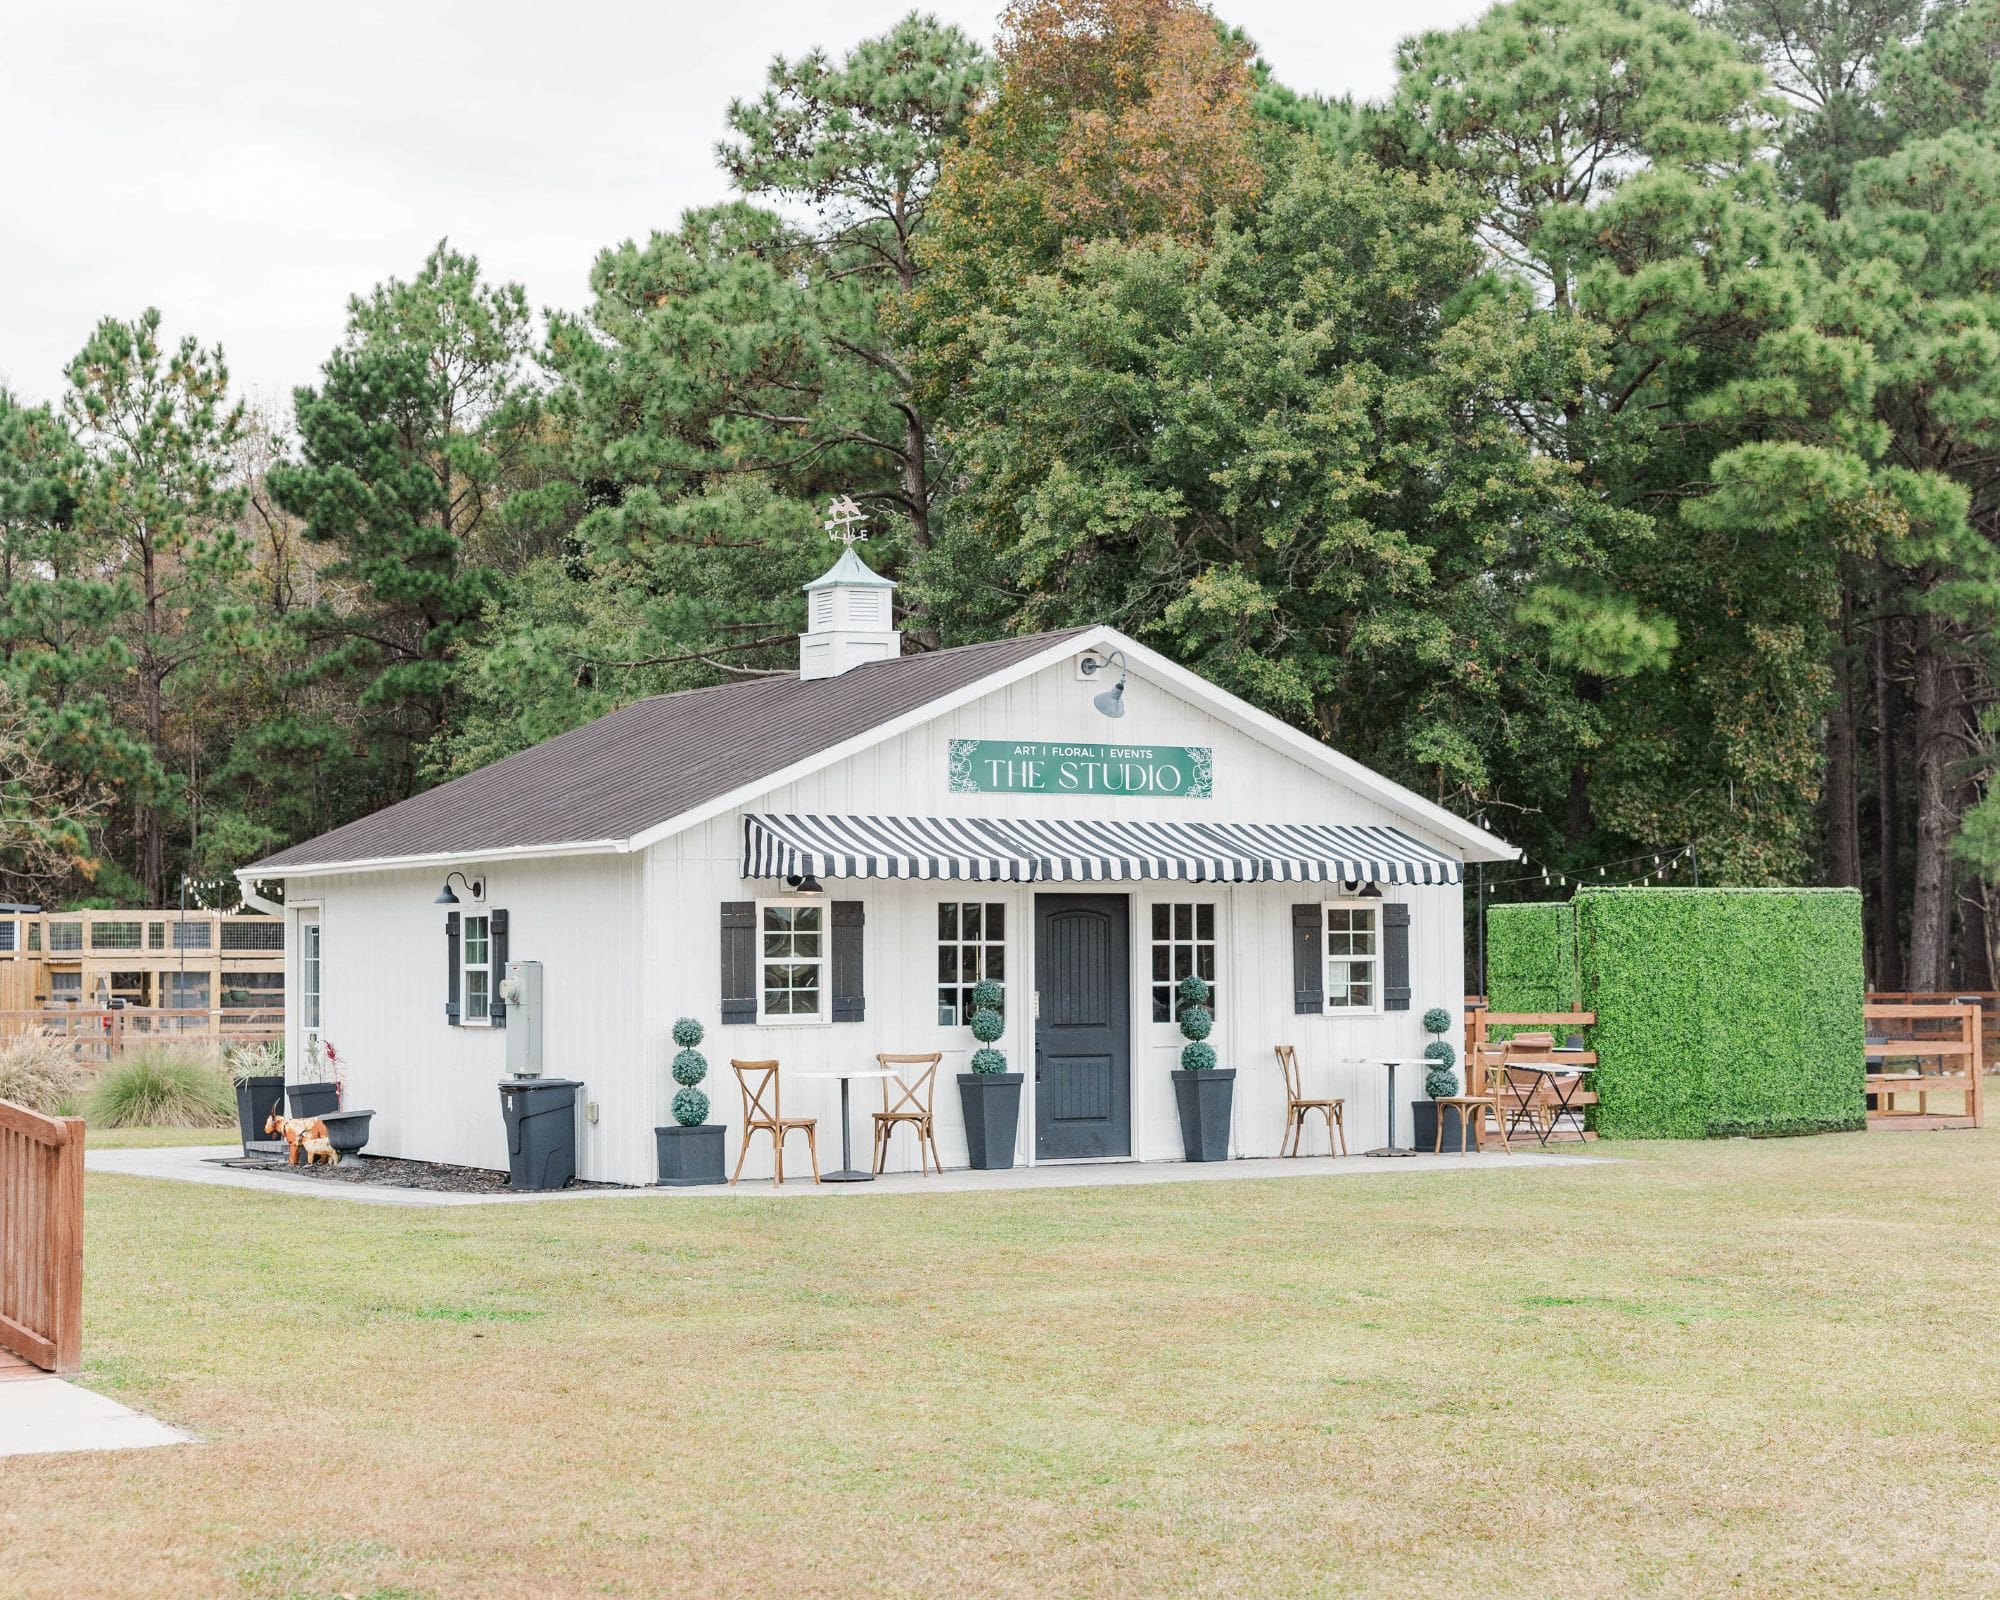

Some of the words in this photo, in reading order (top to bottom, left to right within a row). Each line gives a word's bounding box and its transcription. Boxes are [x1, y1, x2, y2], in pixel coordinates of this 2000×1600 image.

[861, 530, 869, 541] E
[1014, 745, 1036, 756] ART
[1052, 747, 1095, 758] FLORAL
[1110, 748, 1153, 759] EVENTS
[985, 759, 1045, 788] THE
[1058, 761, 1181, 791] STUDIO
